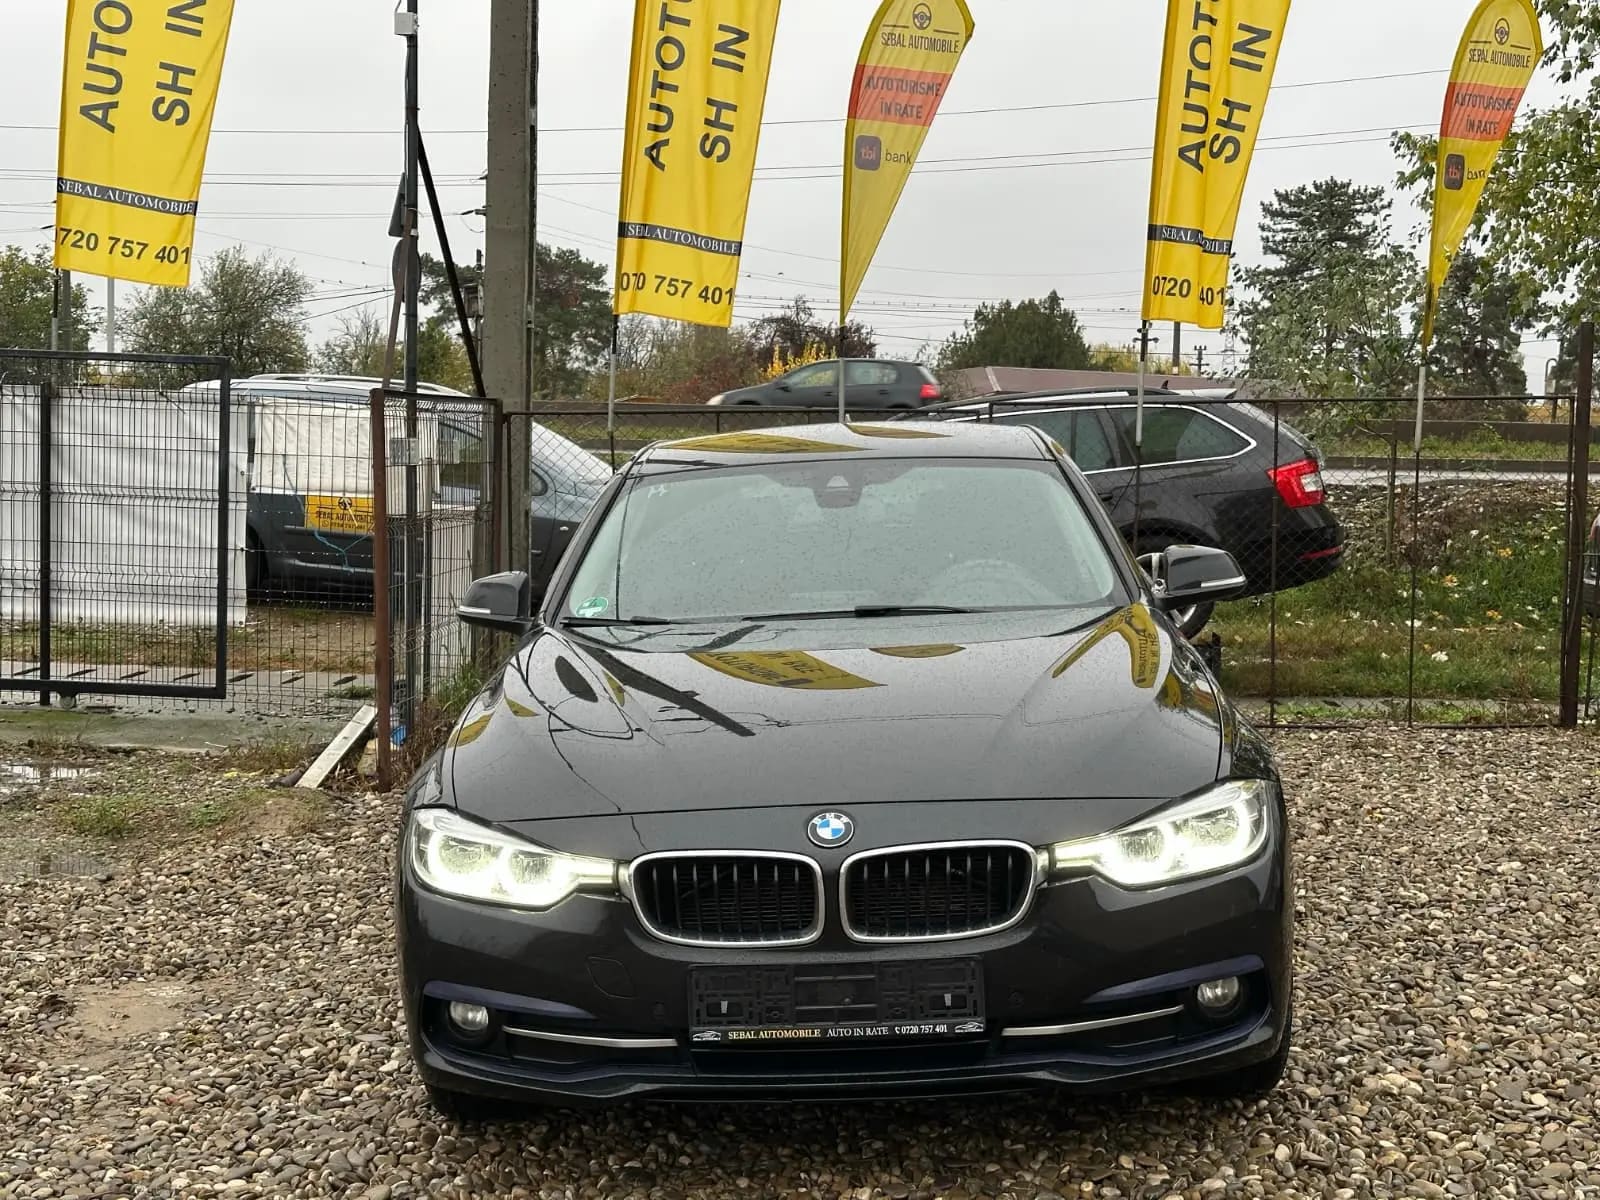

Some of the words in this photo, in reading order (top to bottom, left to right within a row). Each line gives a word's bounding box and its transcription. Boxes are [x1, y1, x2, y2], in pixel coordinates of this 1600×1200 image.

[712, 24, 750, 73] IN
[881, 32, 906, 48] SEBAL
[908, 35, 960, 54] AUTOMOBILE
[1230, 23, 1273, 73] IN
[1490, 51, 1531, 68] AUTOMOBILE
[152, 62, 197, 126] SH
[644, 0, 693, 172] AUTOT
[864, 76, 941, 97] AUTOTURISME
[1178, 0, 1219, 174] AUTOT
[895, 103, 923, 119] RATE
[700, 97, 738, 163] SH
[1209, 98, 1252, 164] SH
[1477, 121, 1499, 135] RATE
[885, 149, 912, 165] bank
[1467, 168, 1486, 180] ban
[58, 179, 102, 198] SEBAL
[56, 227, 99, 252] 720
[108, 236, 149, 260] 757
[154, 245, 190, 265] 401
[652, 229, 738, 254] AUTOMOBILE
[1162, 226, 1194, 242] SEBAL
[654, 274, 693, 299] 757
[698, 285, 735, 306] 401
[1152, 275, 1191, 298] 0720
[1199, 285, 1225, 306] 401
[728, 1030, 757, 1040] SEBAL
[758, 1028, 821, 1039] AUTOMOBILE
[827, 1027, 851, 1037] AUTO
[853, 1027, 864, 1036] IN
[866, 1026, 889, 1036] RATE
[901, 1025, 919, 1034] 0720
